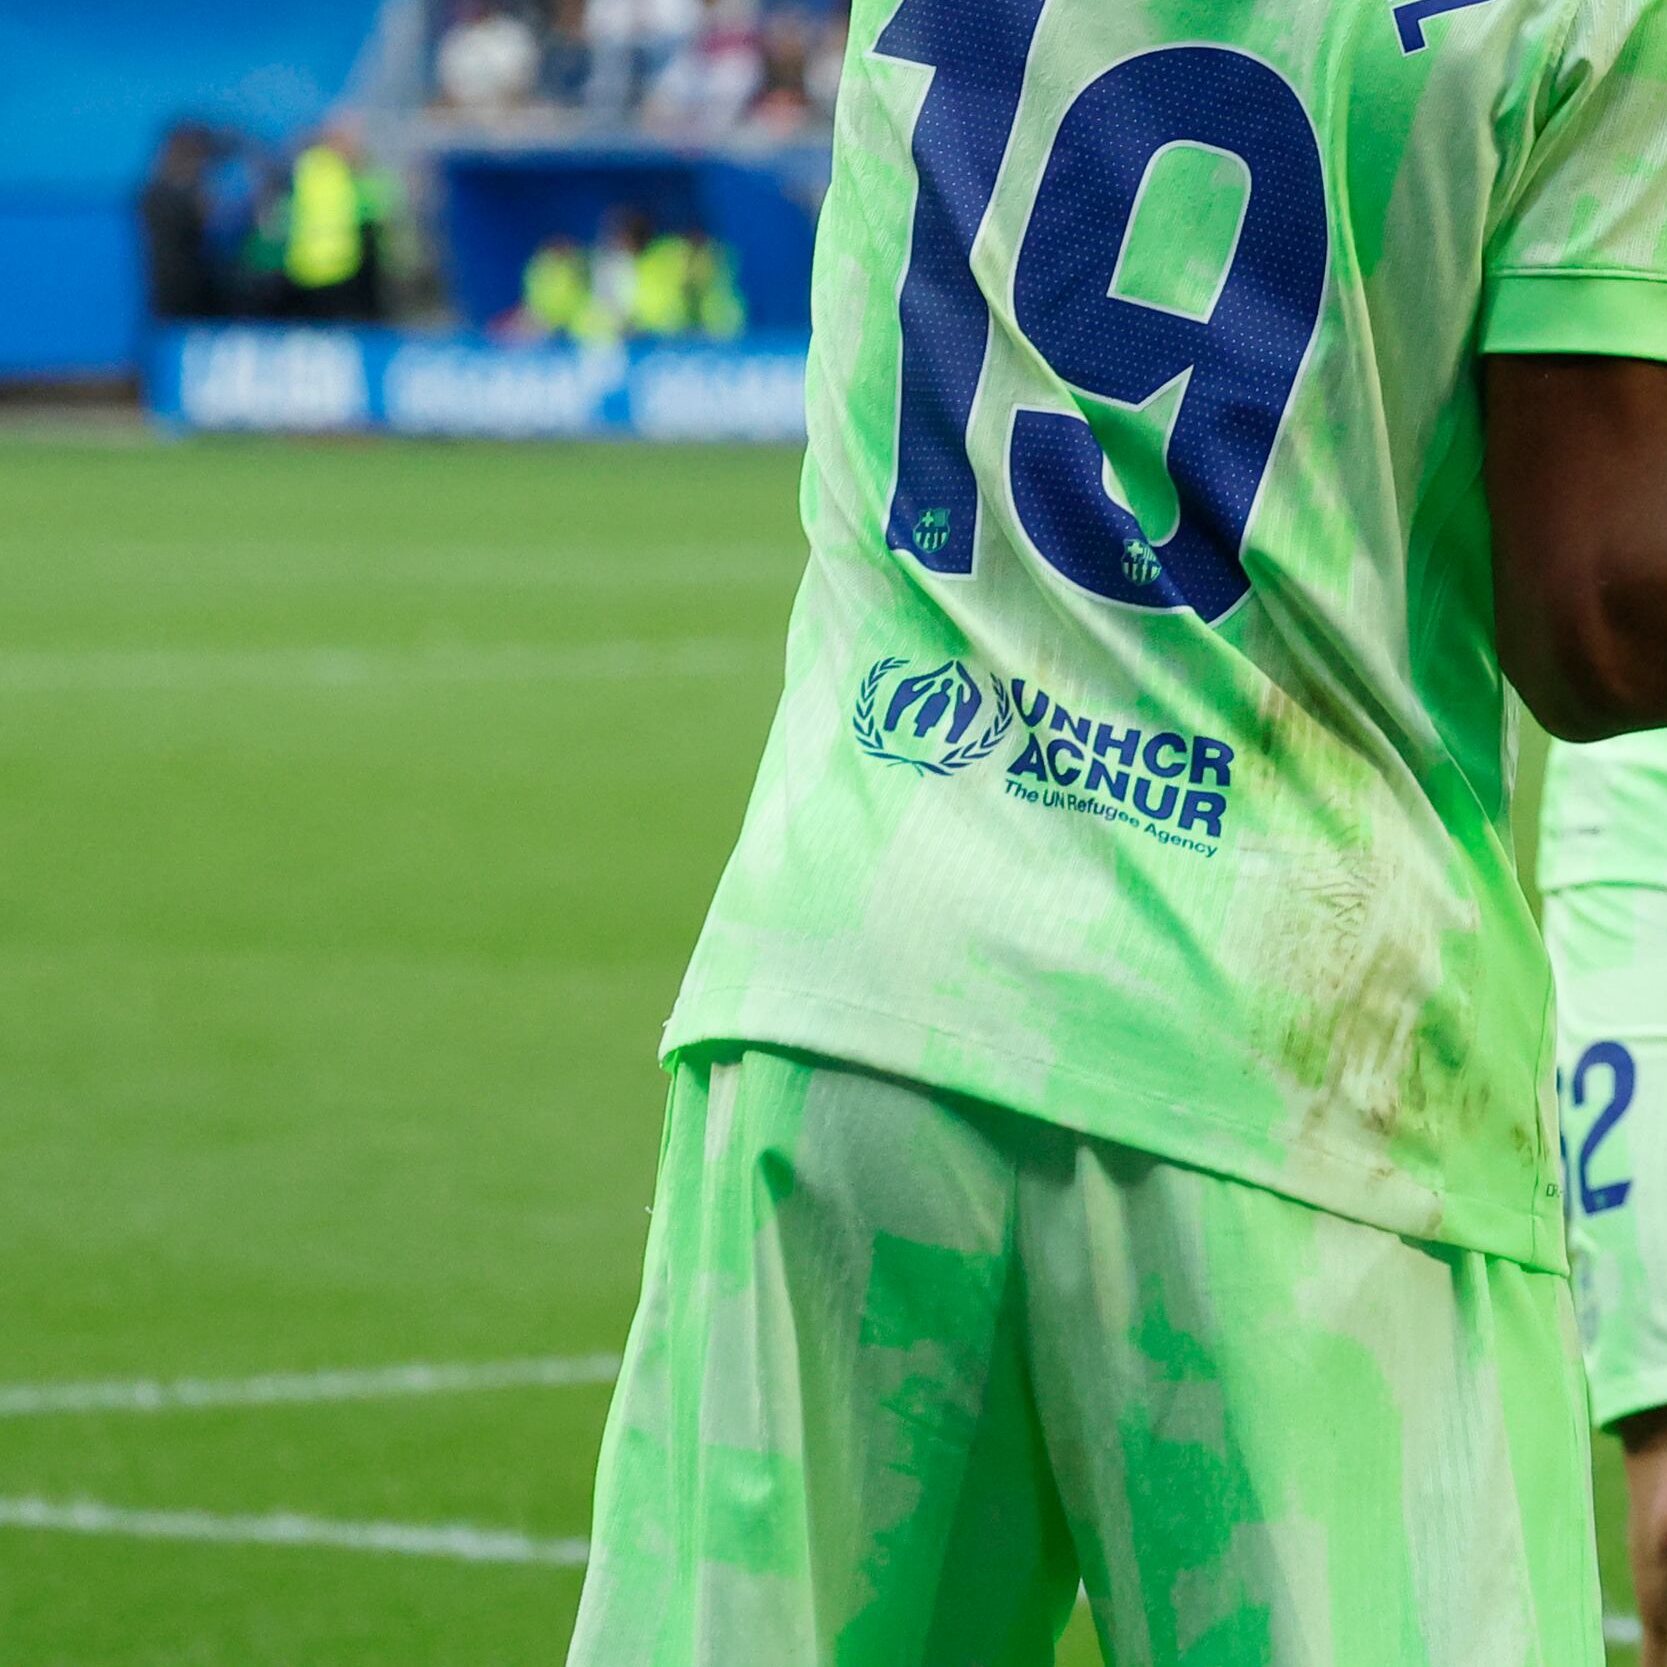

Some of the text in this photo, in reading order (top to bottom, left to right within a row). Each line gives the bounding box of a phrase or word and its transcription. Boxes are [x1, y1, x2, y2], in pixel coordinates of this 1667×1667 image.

[1007, 732, 1227, 838] ACNUR
[1011, 678, 1236, 787] UNHCR
[1004, 779, 1218, 859] The UN Refugee Agency
